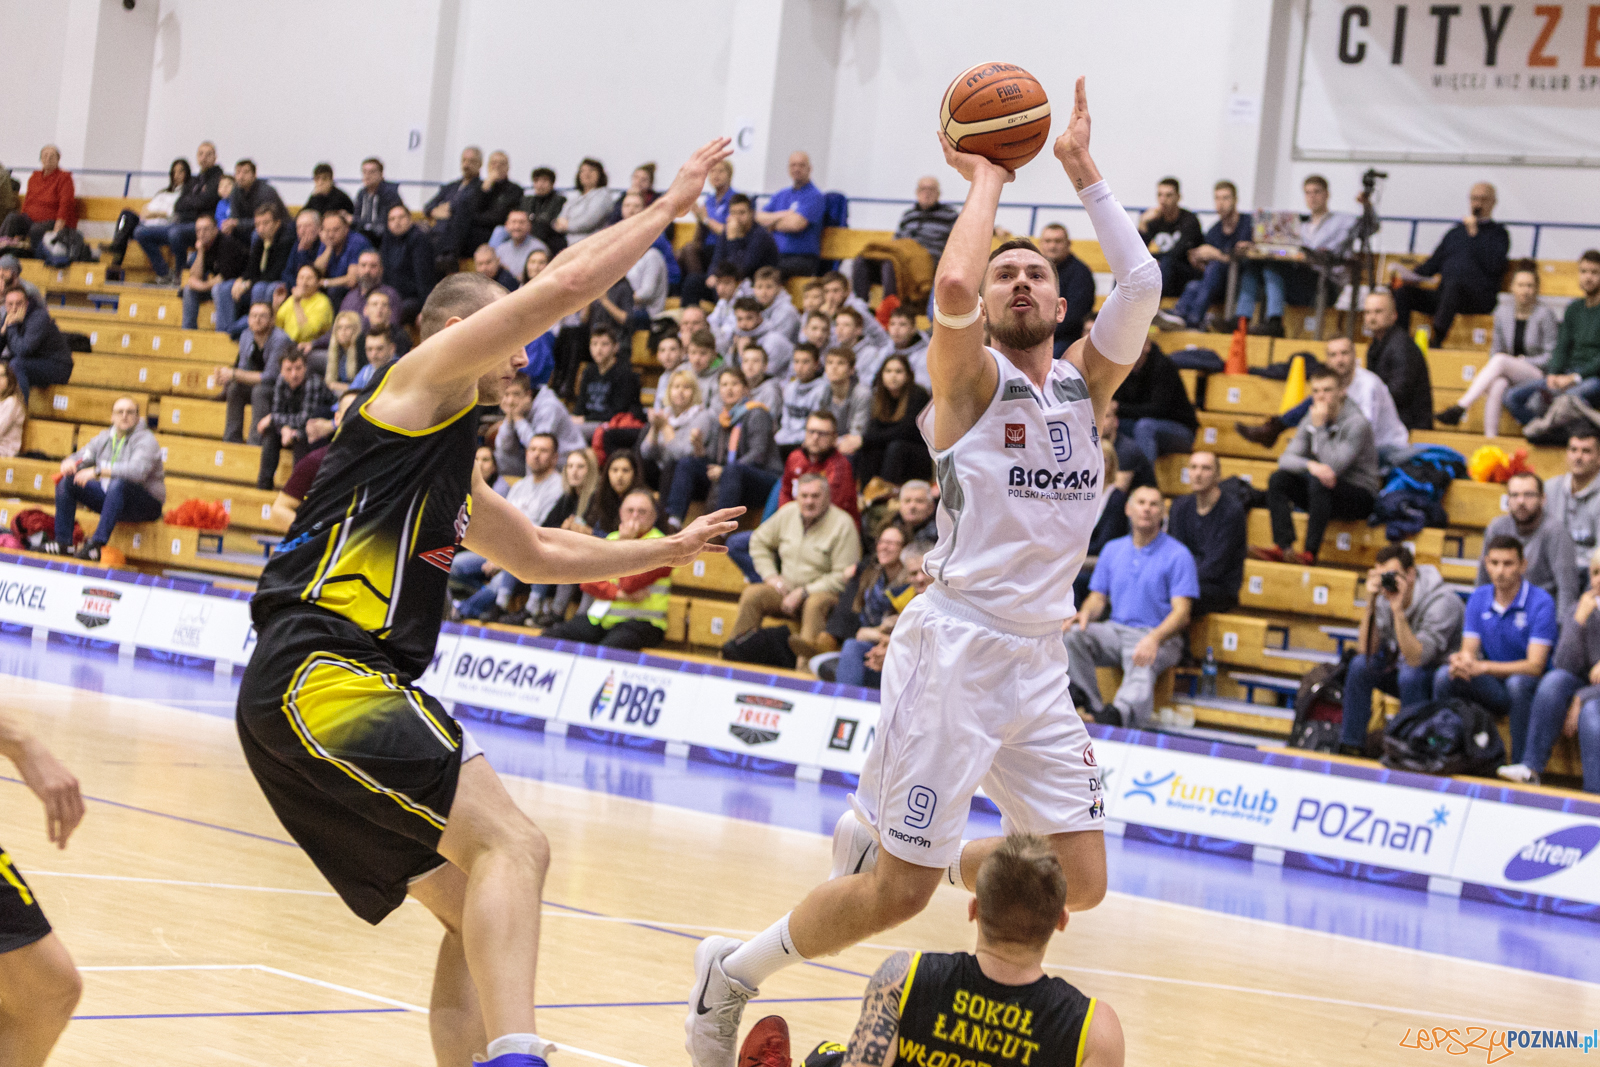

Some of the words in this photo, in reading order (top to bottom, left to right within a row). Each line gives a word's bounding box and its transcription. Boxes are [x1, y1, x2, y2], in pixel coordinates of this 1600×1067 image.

[996, 84, 1021, 99] FIBA
[1001, 94, 1023, 104] APPROVED
[1046, 421, 1072, 462] 9
[1008, 489, 1039, 498] POLSKI
[1041, 491, 1082, 501] PRODUCENT
[0, 579, 47, 611] ICKEL
[82, 596, 112, 616] JOKER
[454, 653, 557, 693] BIOFARM
[610, 682, 665, 726] PBG
[737, 707, 781, 731] JOKER
[904, 785, 937, 830] 9
[1171, 775, 1278, 814] funclub
[1520, 838, 1582, 868] atrem
